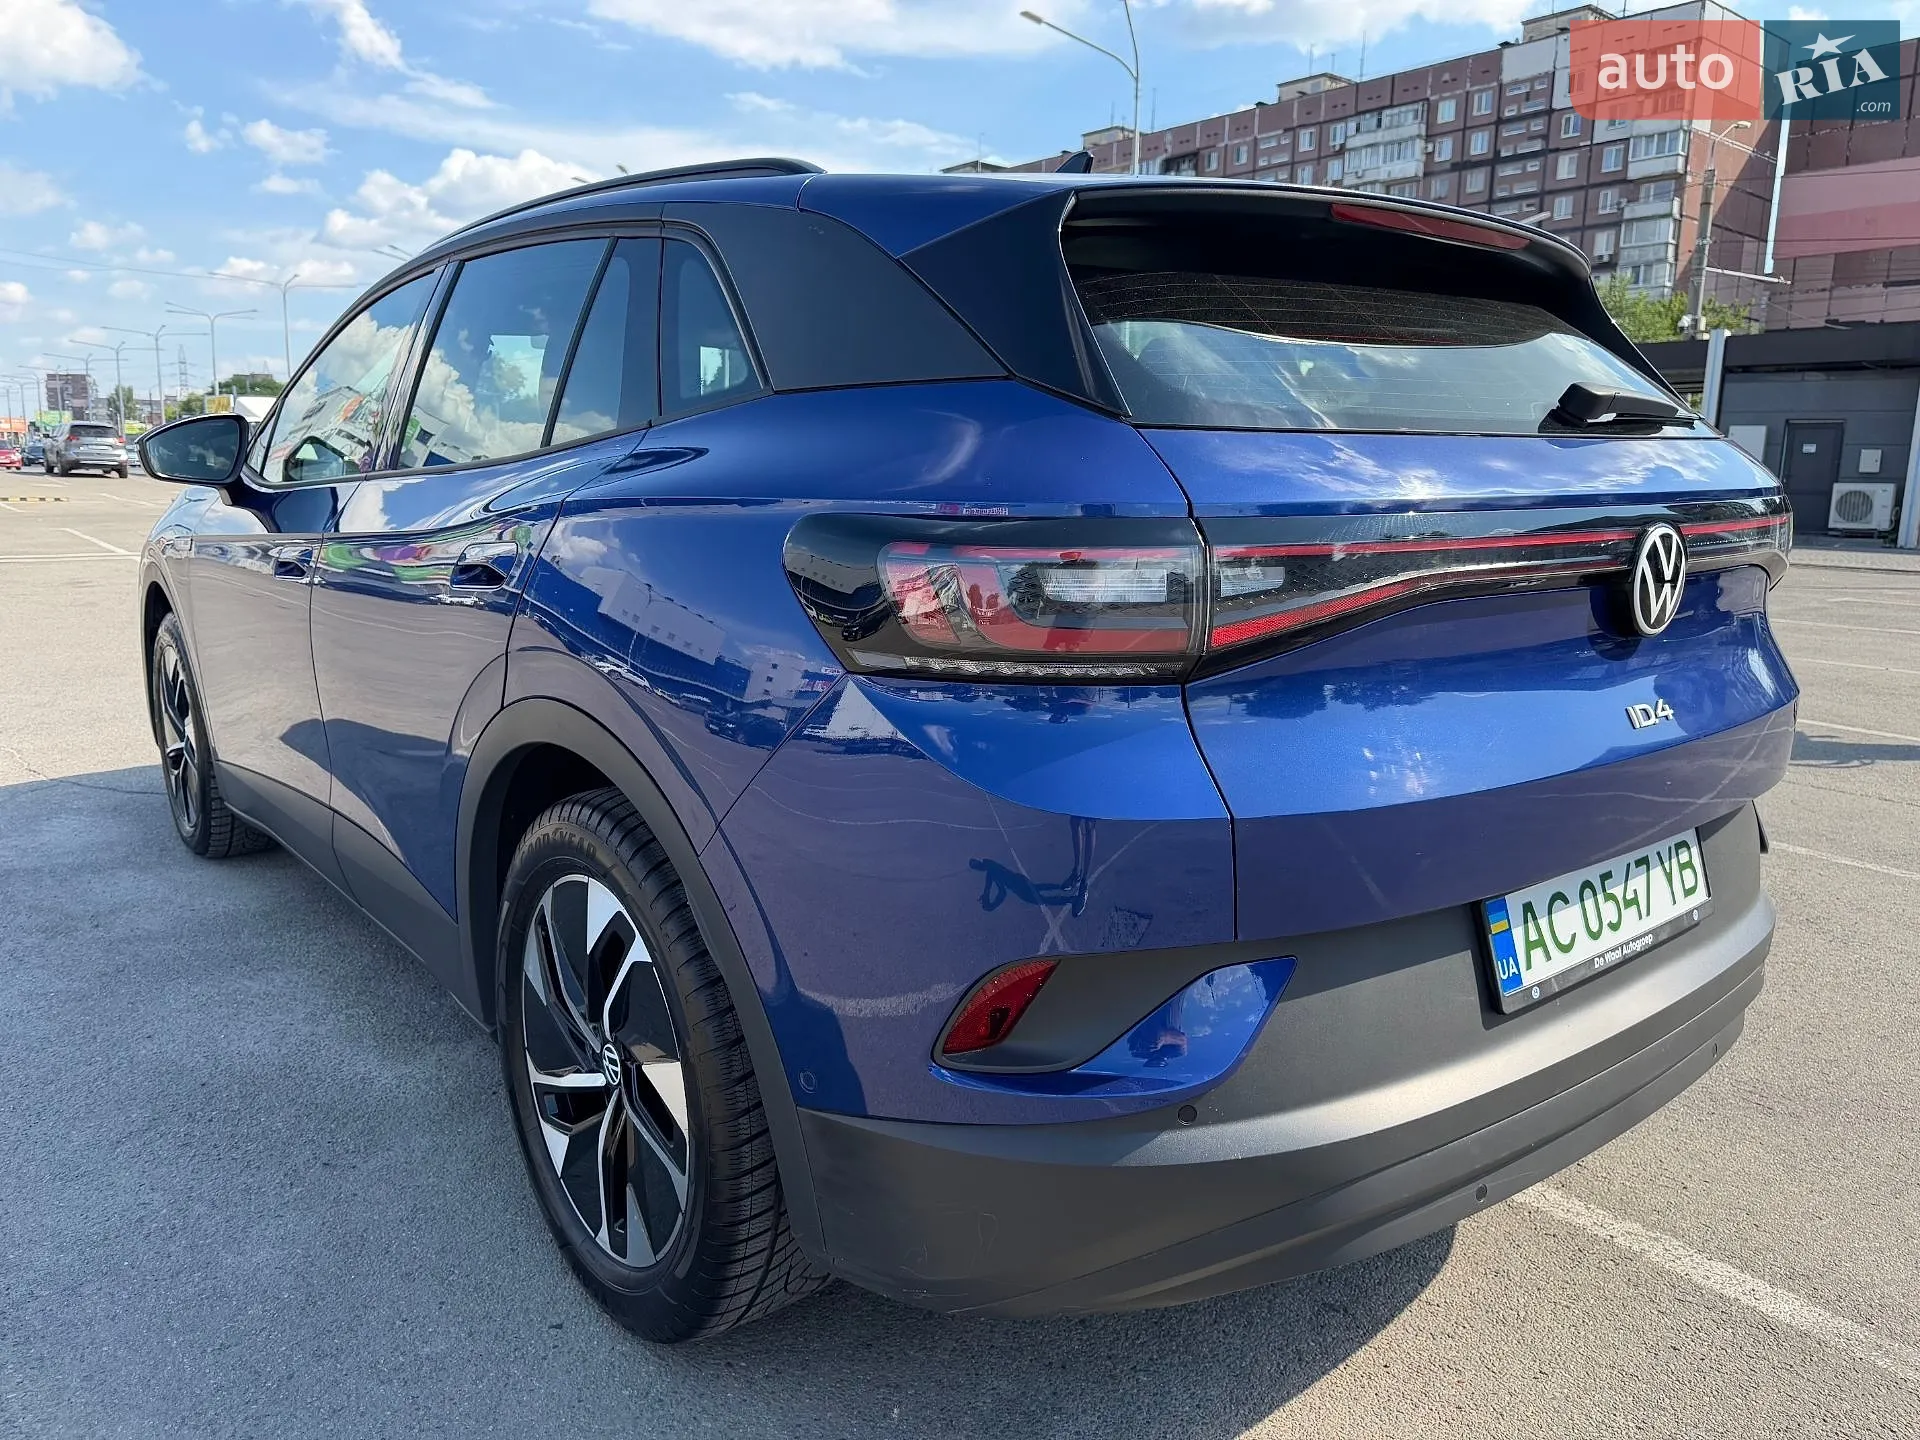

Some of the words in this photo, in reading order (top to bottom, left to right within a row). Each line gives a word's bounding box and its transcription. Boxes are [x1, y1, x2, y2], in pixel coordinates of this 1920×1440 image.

[1522, 891, 1577, 971] AC
[1578, 854, 1651, 941] 0547
[1656, 839, 1698, 905] YB
[1499, 956, 1519, 980] UA
[1594, 957, 1604, 969] De
[1622, 933, 1653, 956] Autogroep
